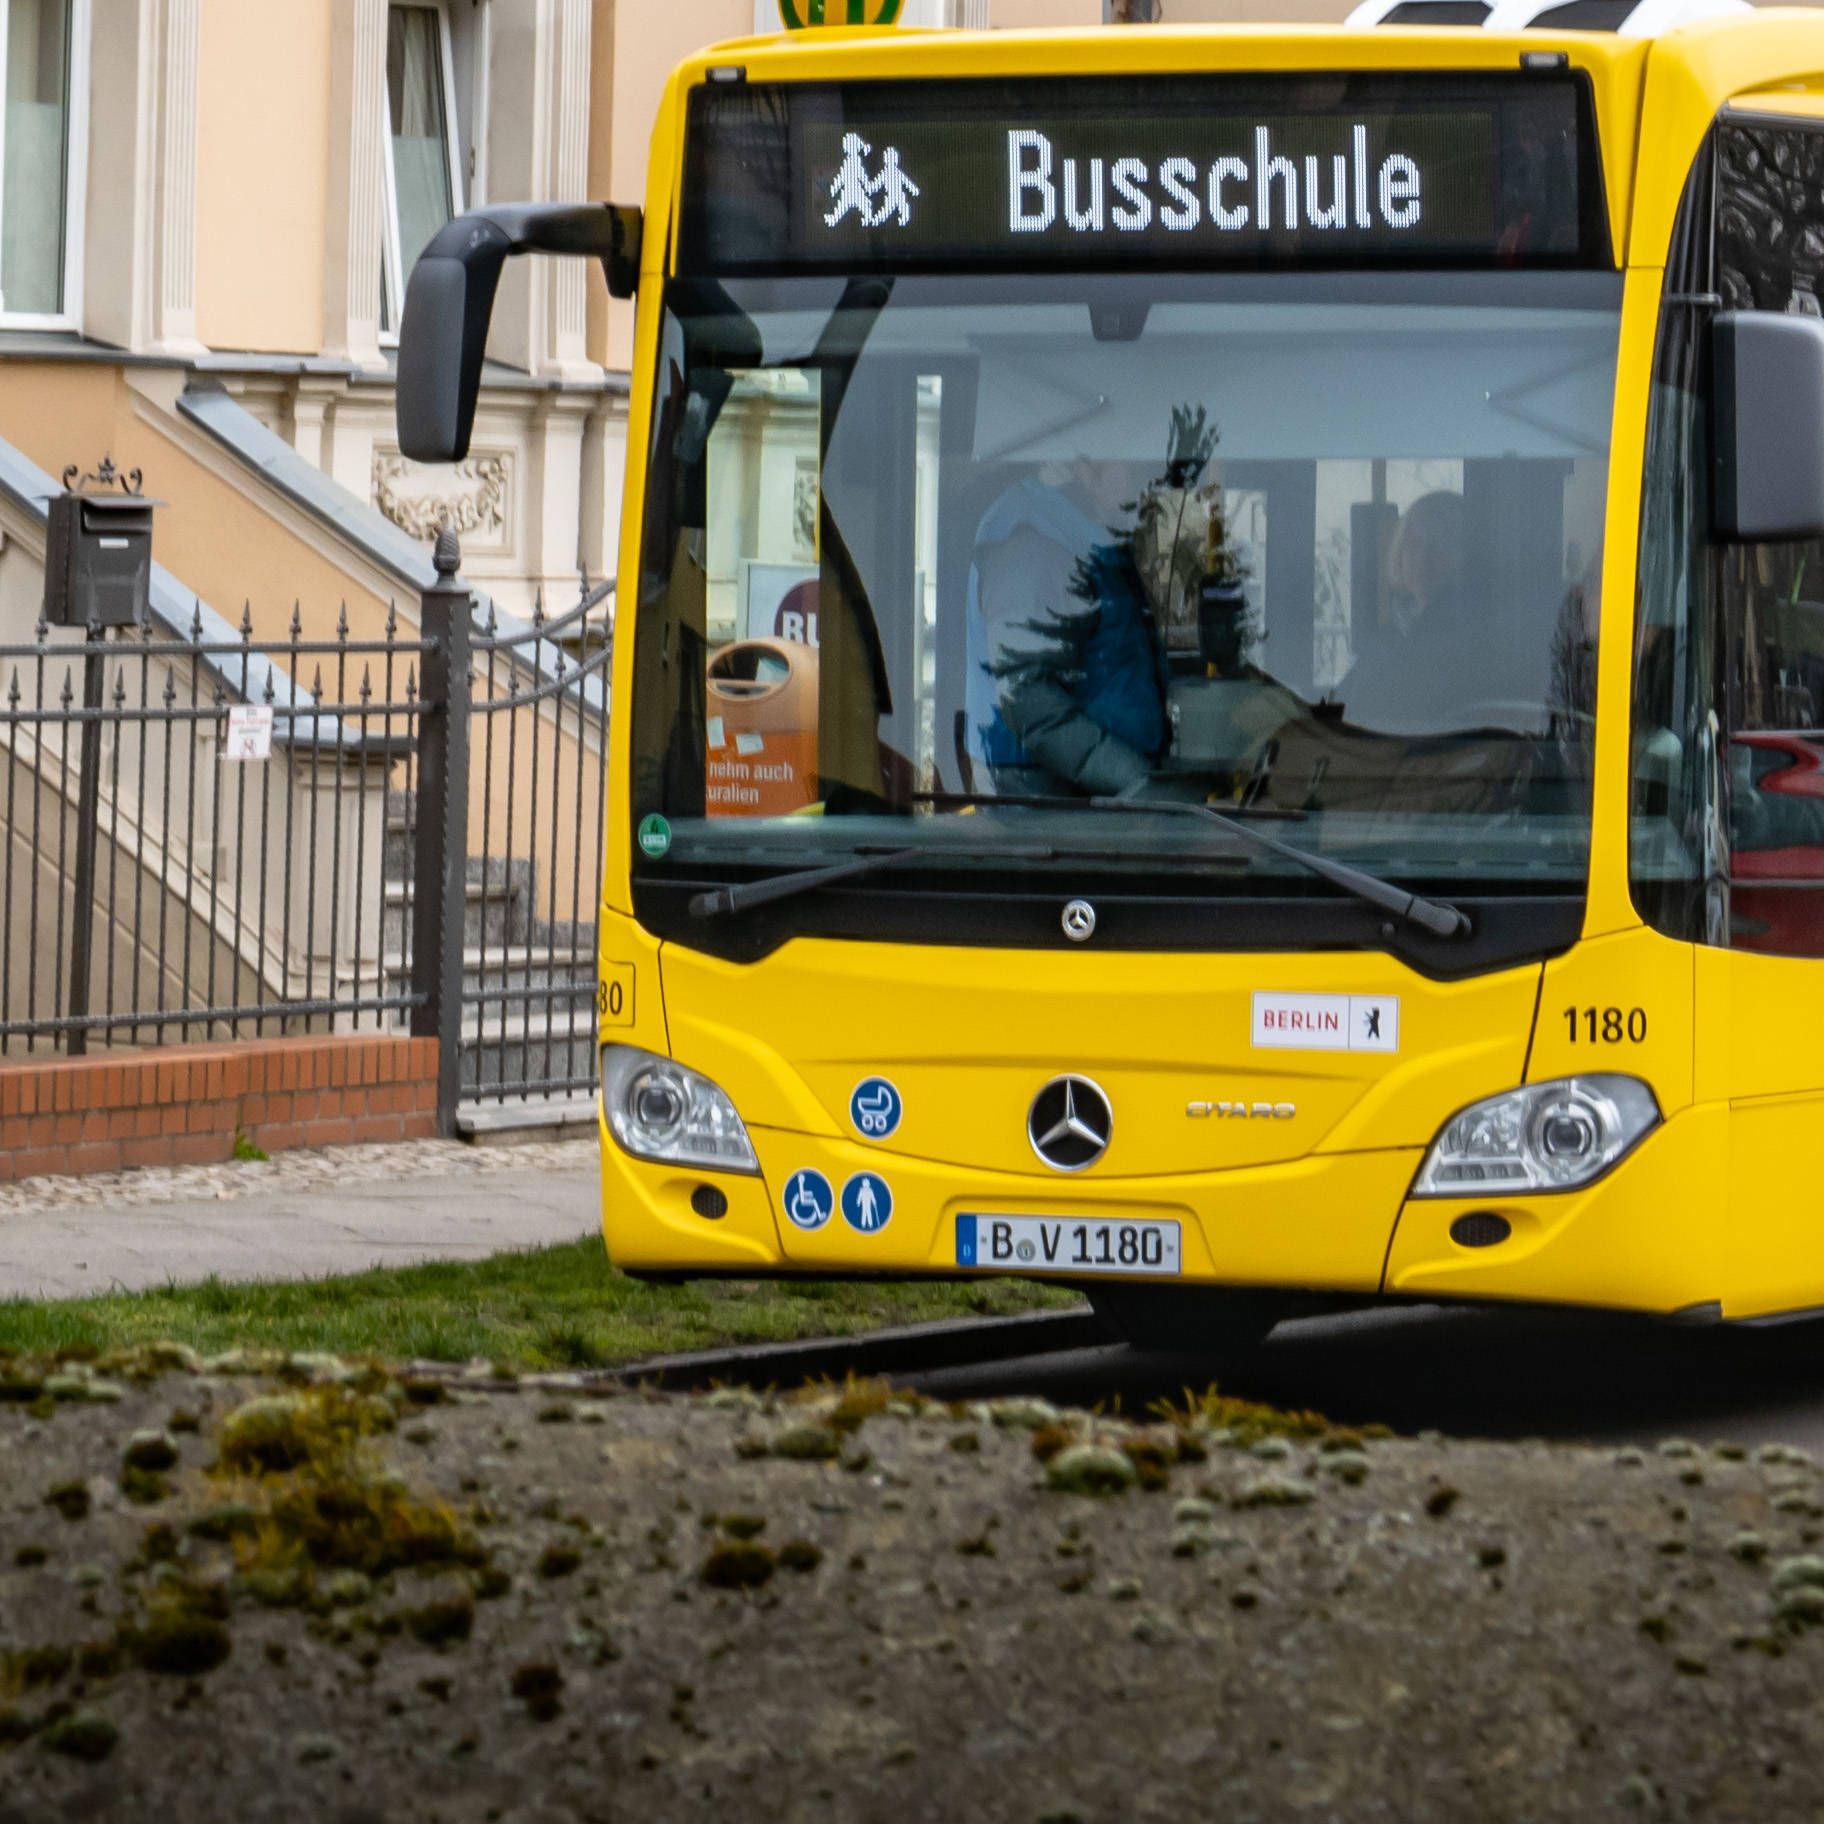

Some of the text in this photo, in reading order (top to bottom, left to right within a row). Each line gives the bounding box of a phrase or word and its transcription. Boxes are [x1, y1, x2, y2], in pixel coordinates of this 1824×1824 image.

[1007, 123, 1421, 232] Busschule
[710, 759, 794, 783] nehm auch
[1263, 1008, 1339, 1032] BERLIN
[1562, 1004, 1648, 1044] 1180
[1184, 1100, 1297, 1120] CITARO
[1071, 1224, 1163, 1265] 1180
